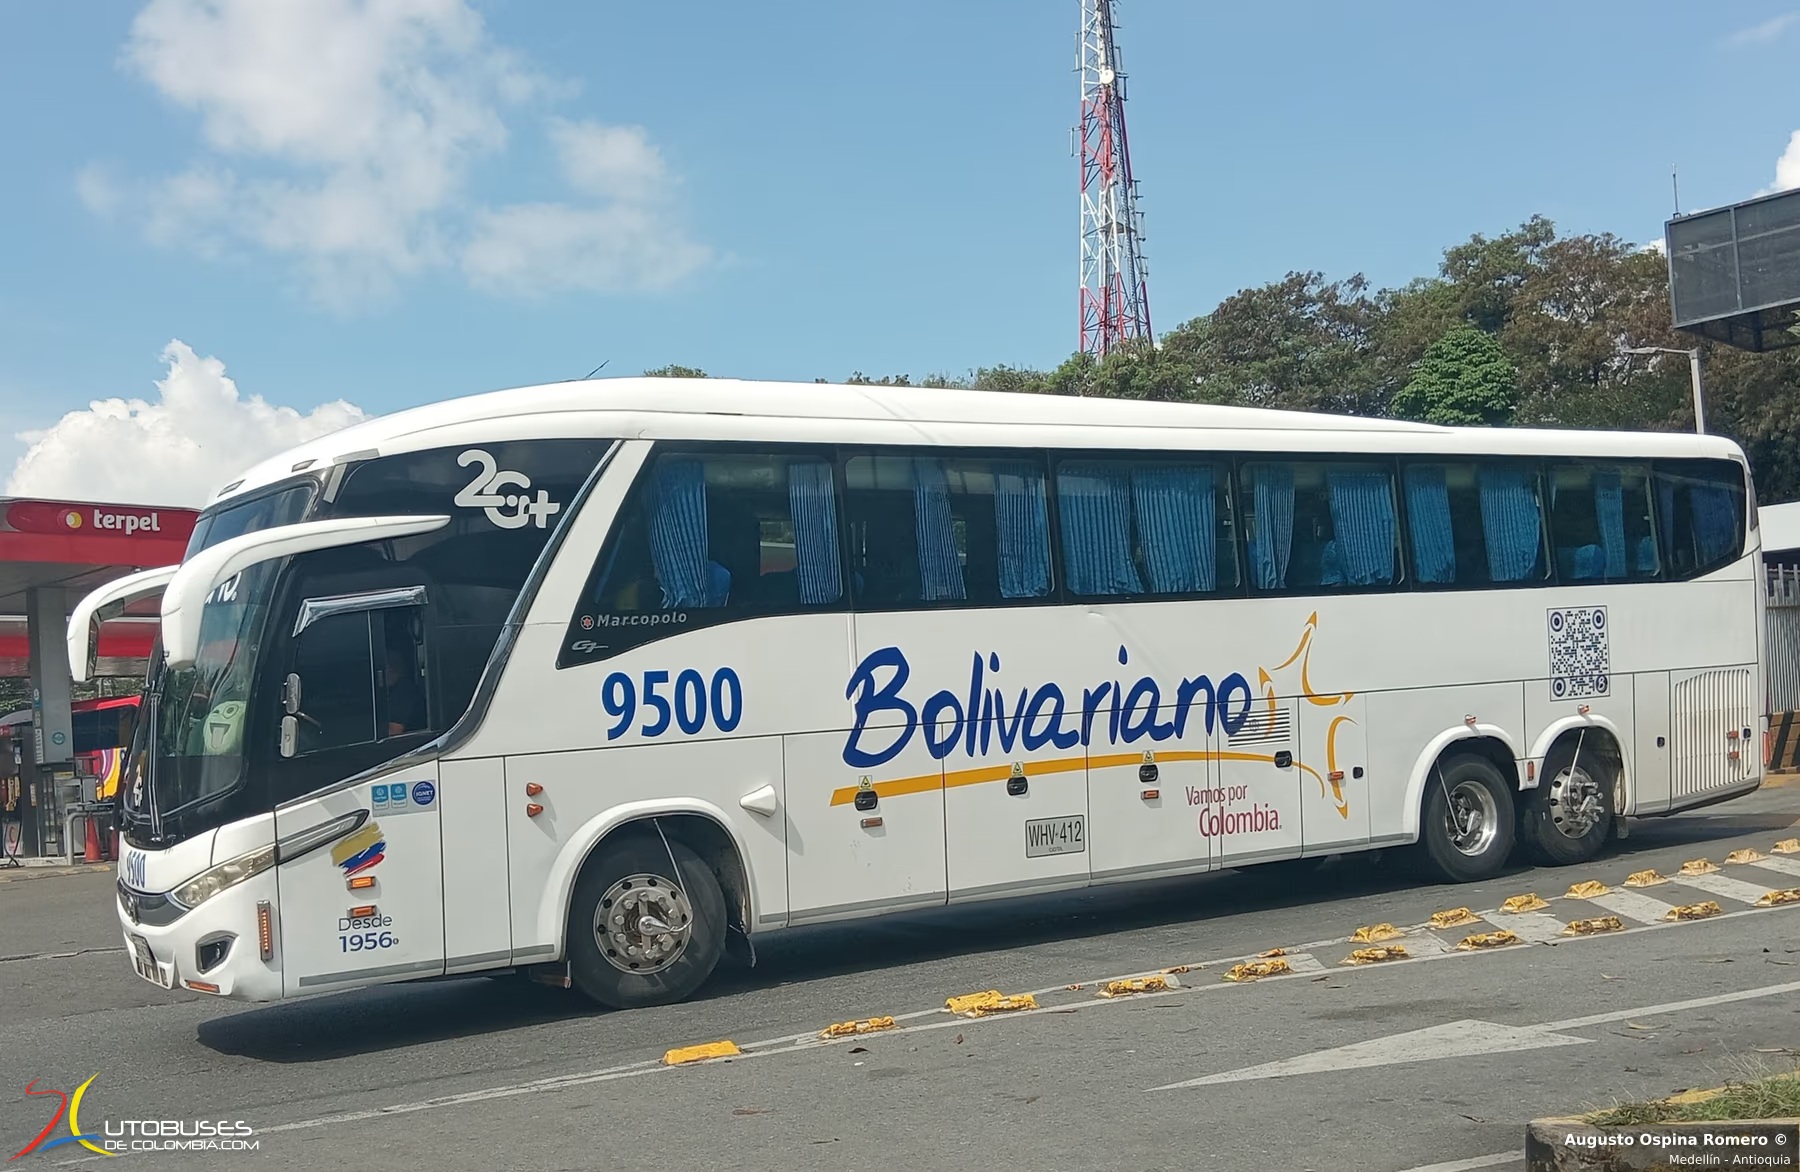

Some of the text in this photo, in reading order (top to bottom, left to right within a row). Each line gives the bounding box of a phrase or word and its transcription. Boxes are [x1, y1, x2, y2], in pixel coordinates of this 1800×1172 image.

[93, 509, 160, 535] terpel
[597, 611, 687, 627] Marcopolo
[601, 666, 743, 741] 9500
[842, 645, 1252, 768] Bolivariano
[1185, 785, 1248, 806] Vamos por
[1028, 820, 1082, 847] WHV-412
[127, 850, 147, 888] 9500
[338, 914, 393, 931] Desde
